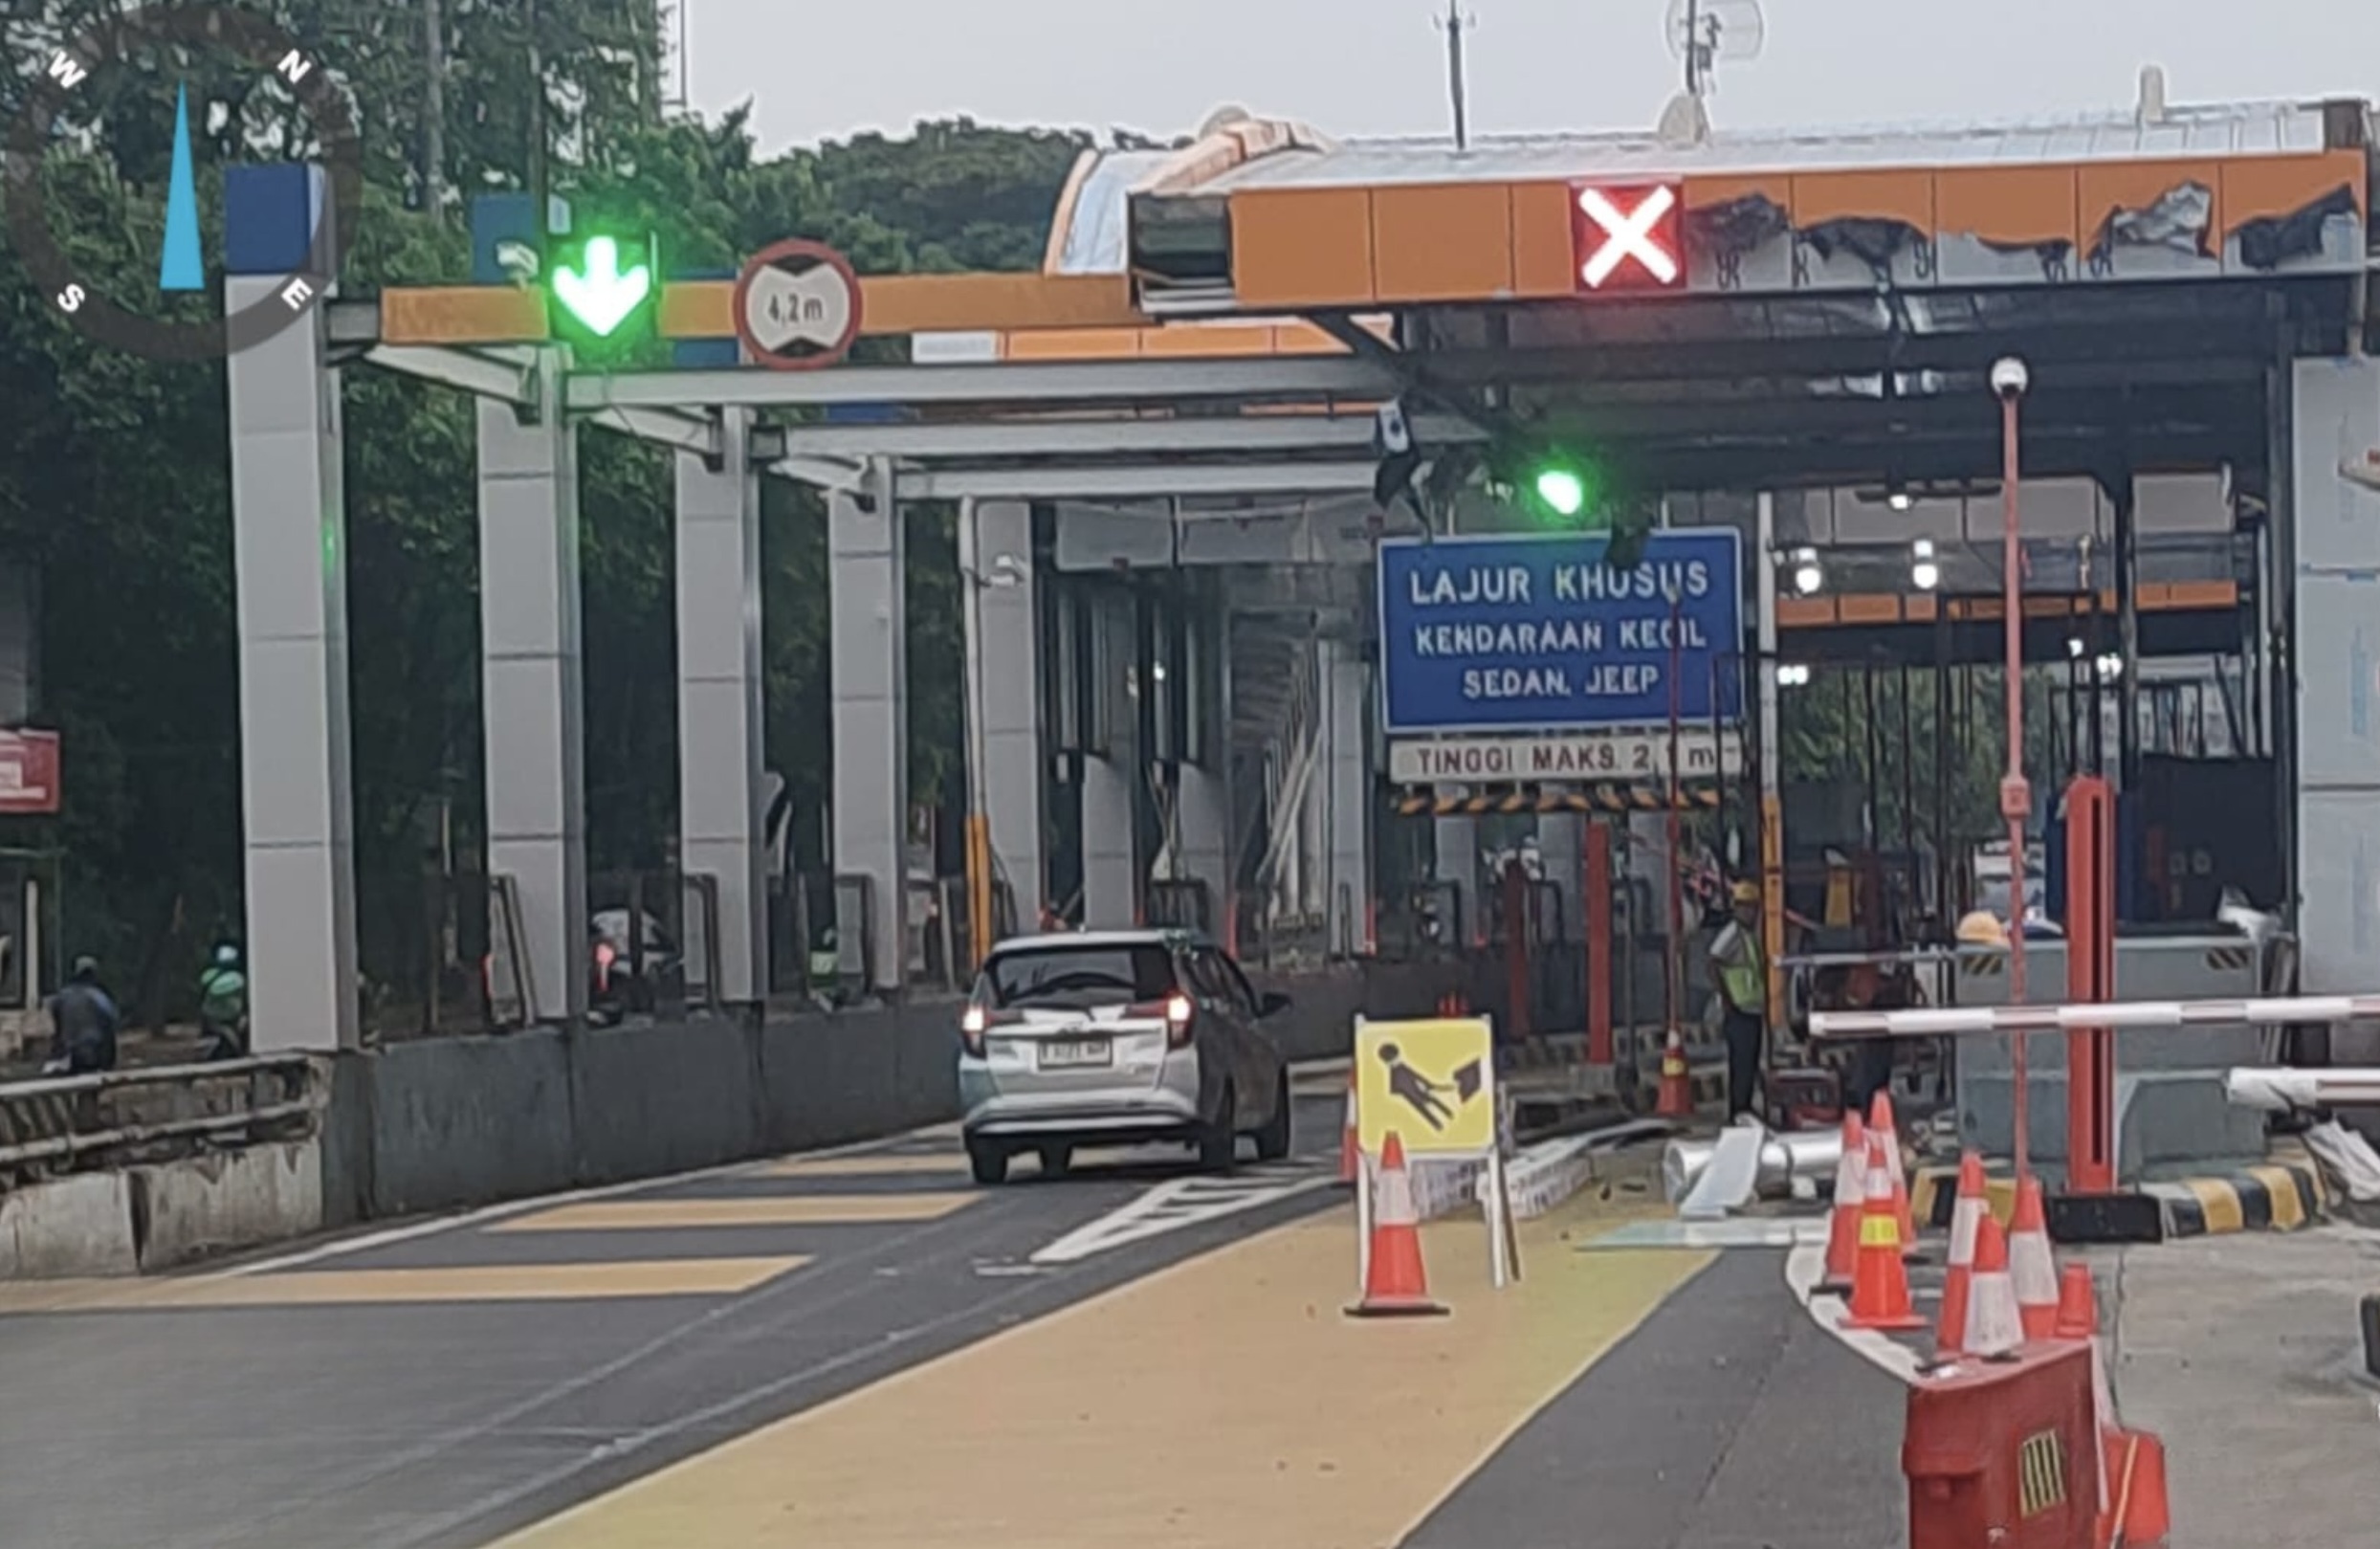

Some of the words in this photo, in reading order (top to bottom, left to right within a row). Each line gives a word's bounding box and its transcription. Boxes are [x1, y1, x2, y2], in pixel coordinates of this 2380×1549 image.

[803, 298, 823, 321] m
[1411, 566, 1531, 605] LAJUR
[1555, 561, 1708, 601] KHUSUS
[1416, 622, 1602, 655] KENDARAAN
[1620, 617, 1707, 649] KECIL
[1585, 665, 1660, 696] JEEP
[1417, 745, 1512, 774] TINGGI
